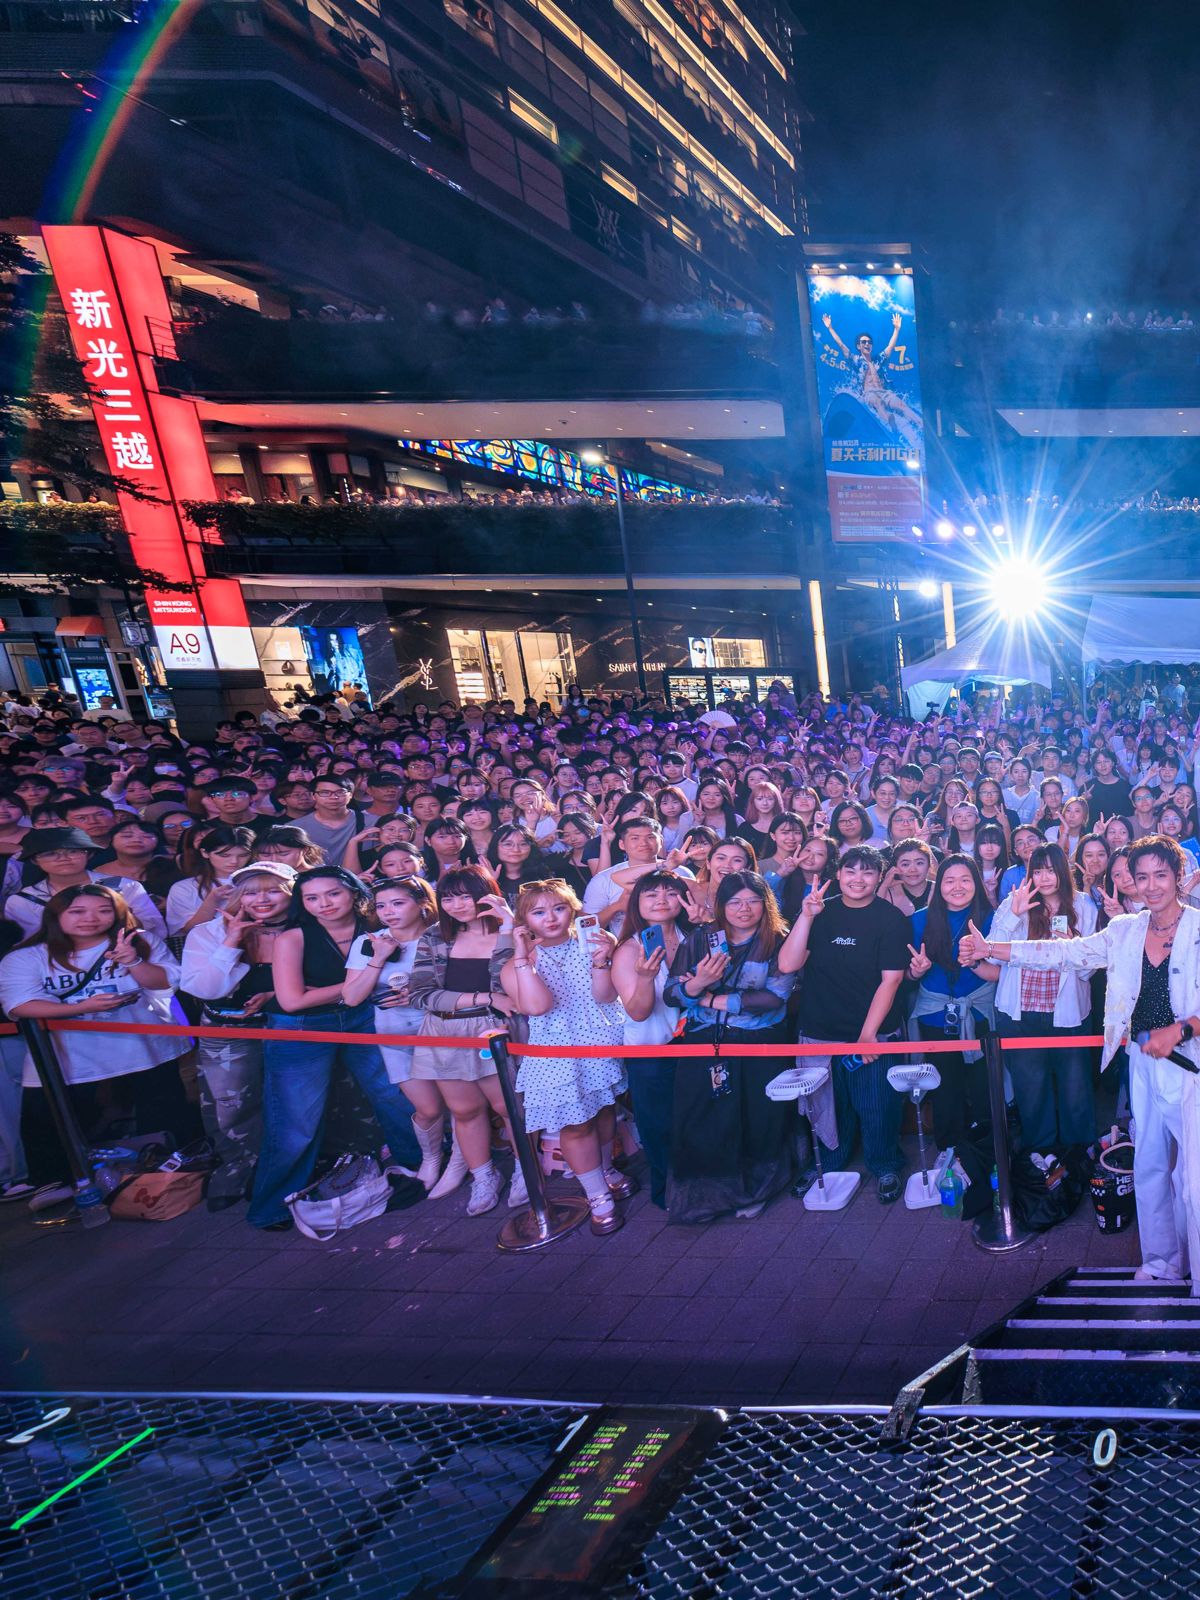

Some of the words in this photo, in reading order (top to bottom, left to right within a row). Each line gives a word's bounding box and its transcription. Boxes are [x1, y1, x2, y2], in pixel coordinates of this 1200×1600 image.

[69, 288, 154, 470] 新光三越
[170, 632, 201, 655] A9
[608, 662, 631, 673] SAINT
[5, 1406, 72, 1444] 2
[556, 1414, 590, 1453] 1
[1093, 1428, 1117, 1467] 0
